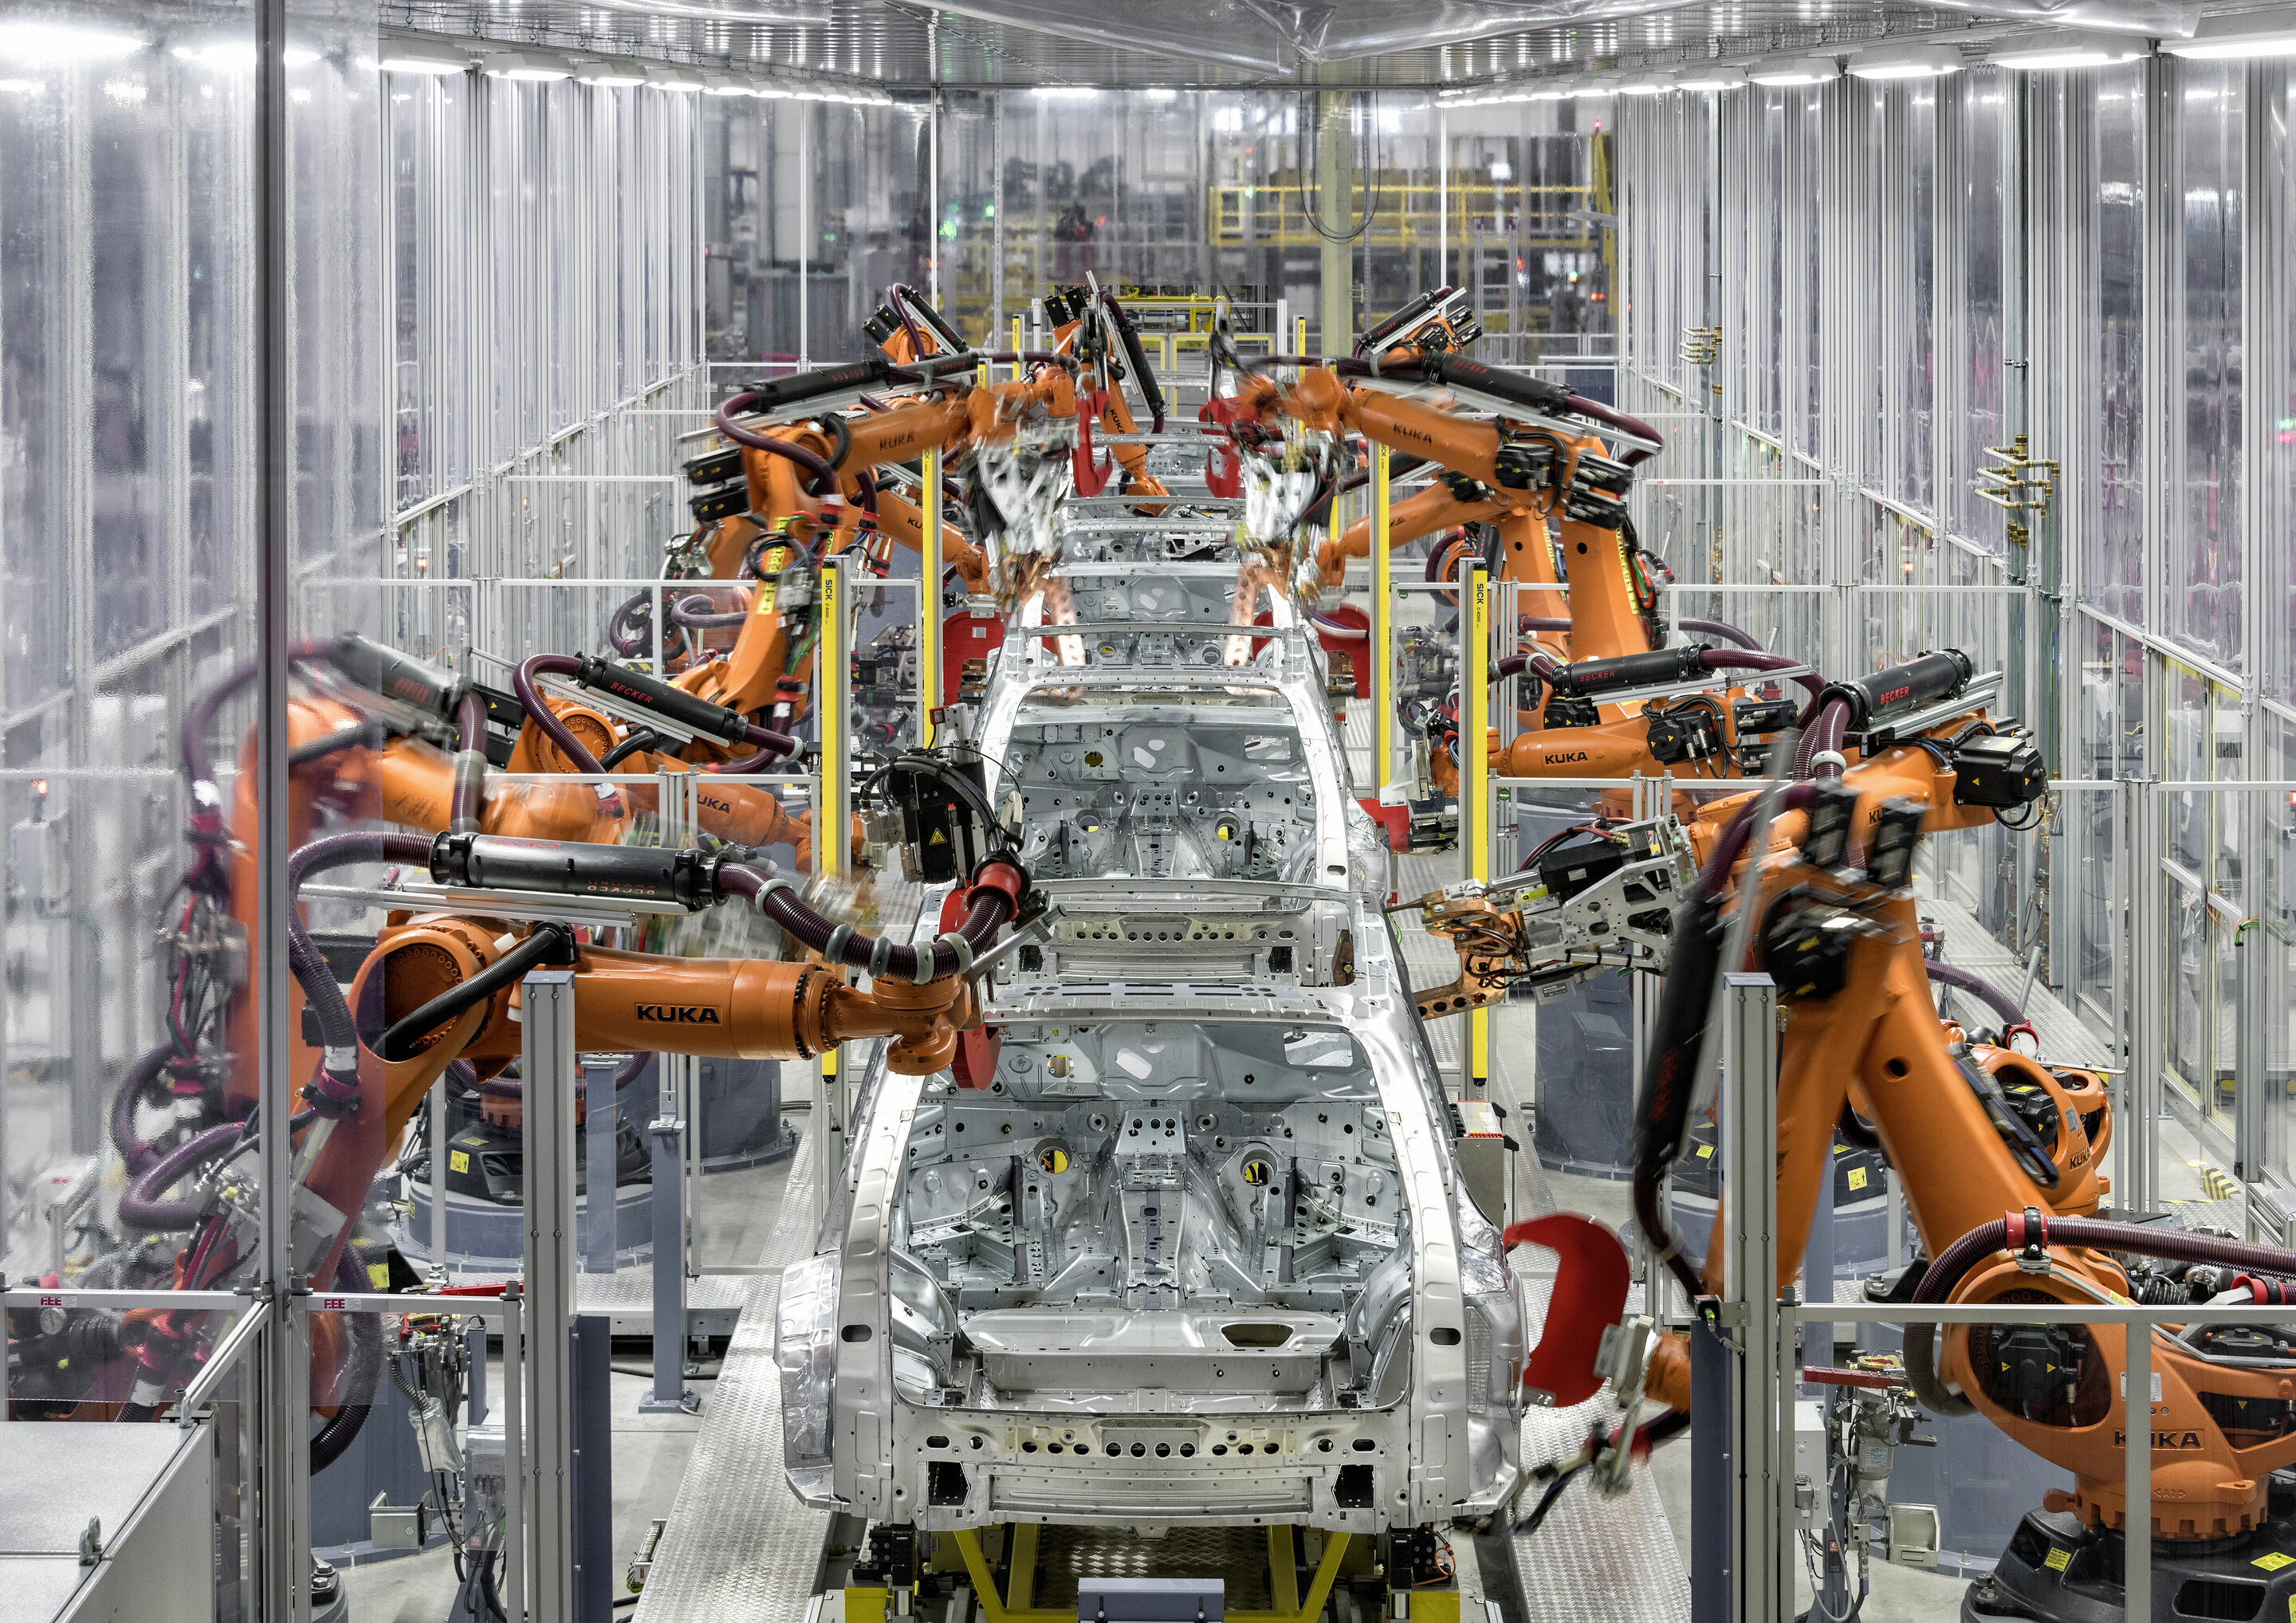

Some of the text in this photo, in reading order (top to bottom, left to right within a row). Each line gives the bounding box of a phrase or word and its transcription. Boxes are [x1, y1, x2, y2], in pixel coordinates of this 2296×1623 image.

[1378, 321, 1397, 337] BECKER
[1451, 359, 1490, 375] BECKER
[879, 431, 915, 451] KUKA
[1391, 422, 1433, 444] KUKA
[907, 517, 923, 530] KU
[1579, 670, 1616, 682] BECKER
[610, 682, 654, 703] BECKER
[1880, 686, 1910, 705] BECKER
[1545, 752, 1589, 764] KUKA
[684, 789, 731, 815] UKA
[490, 838, 562, 851] BECKER
[588, 880, 657, 896] BECKER
[637, 1004, 720, 1024] KUKA
[2114, 1431, 2201, 1448] KKA
